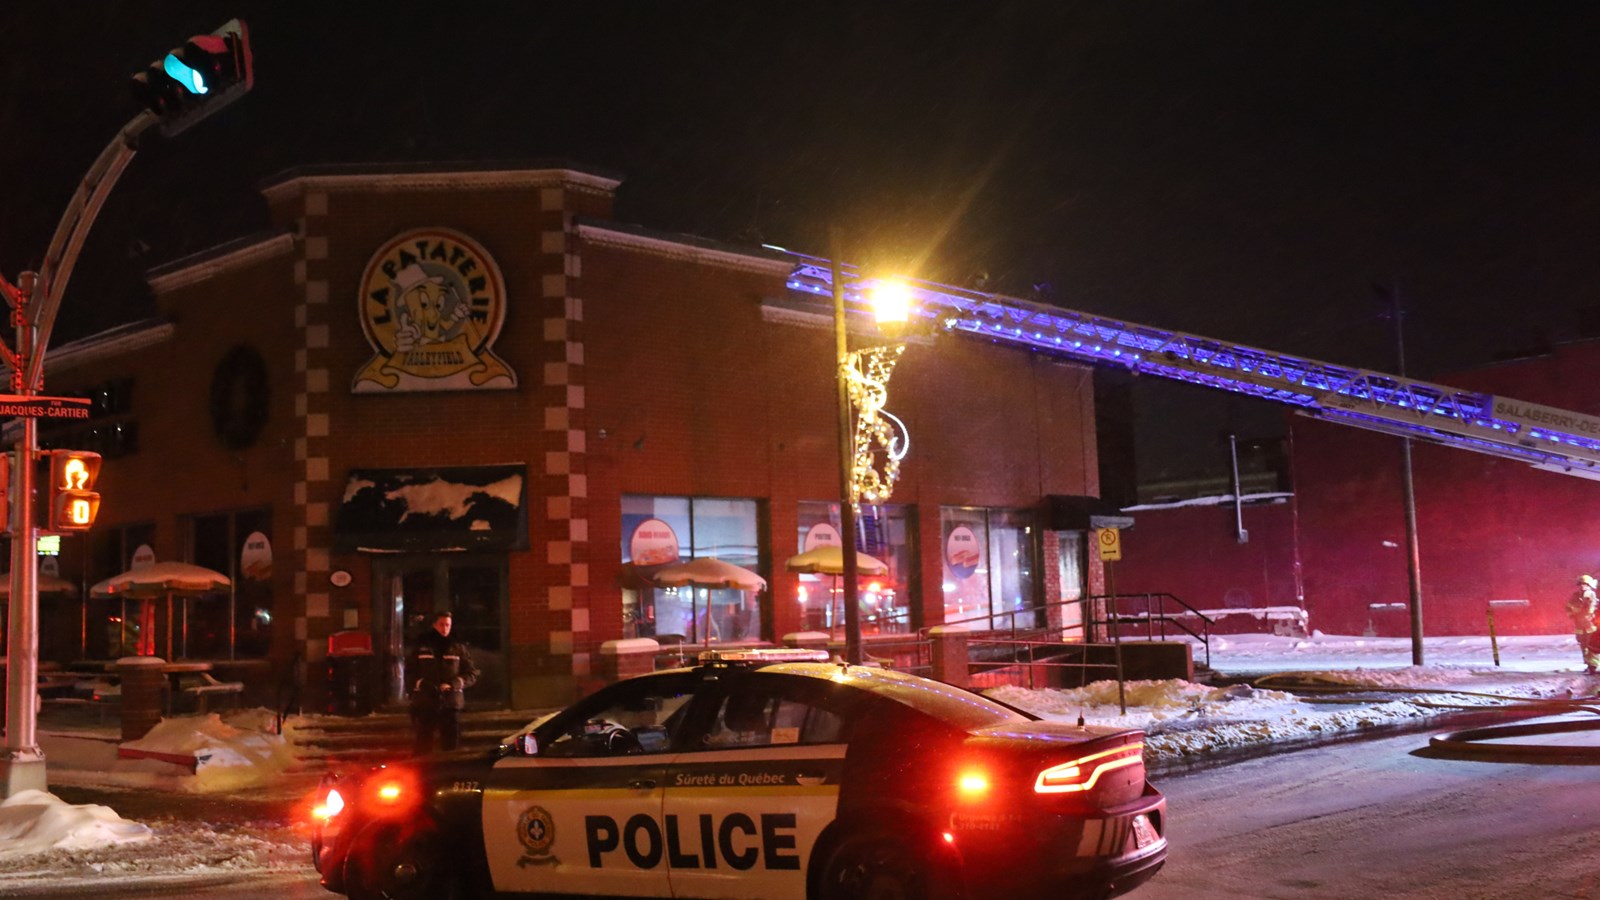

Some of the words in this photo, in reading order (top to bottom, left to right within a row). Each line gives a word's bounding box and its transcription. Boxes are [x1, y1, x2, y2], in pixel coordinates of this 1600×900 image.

[370, 286, 392, 325] LA
[381, 240, 489, 324] PATATERIE
[0, 405, 89, 418] JACQUES-CARTIER
[675, 773, 716, 786] Sûreté
[719, 774, 736, 785] du
[738, 772, 785, 786] Québec
[453, 781, 479, 793] 8137
[585, 812, 800, 871] POLICE
